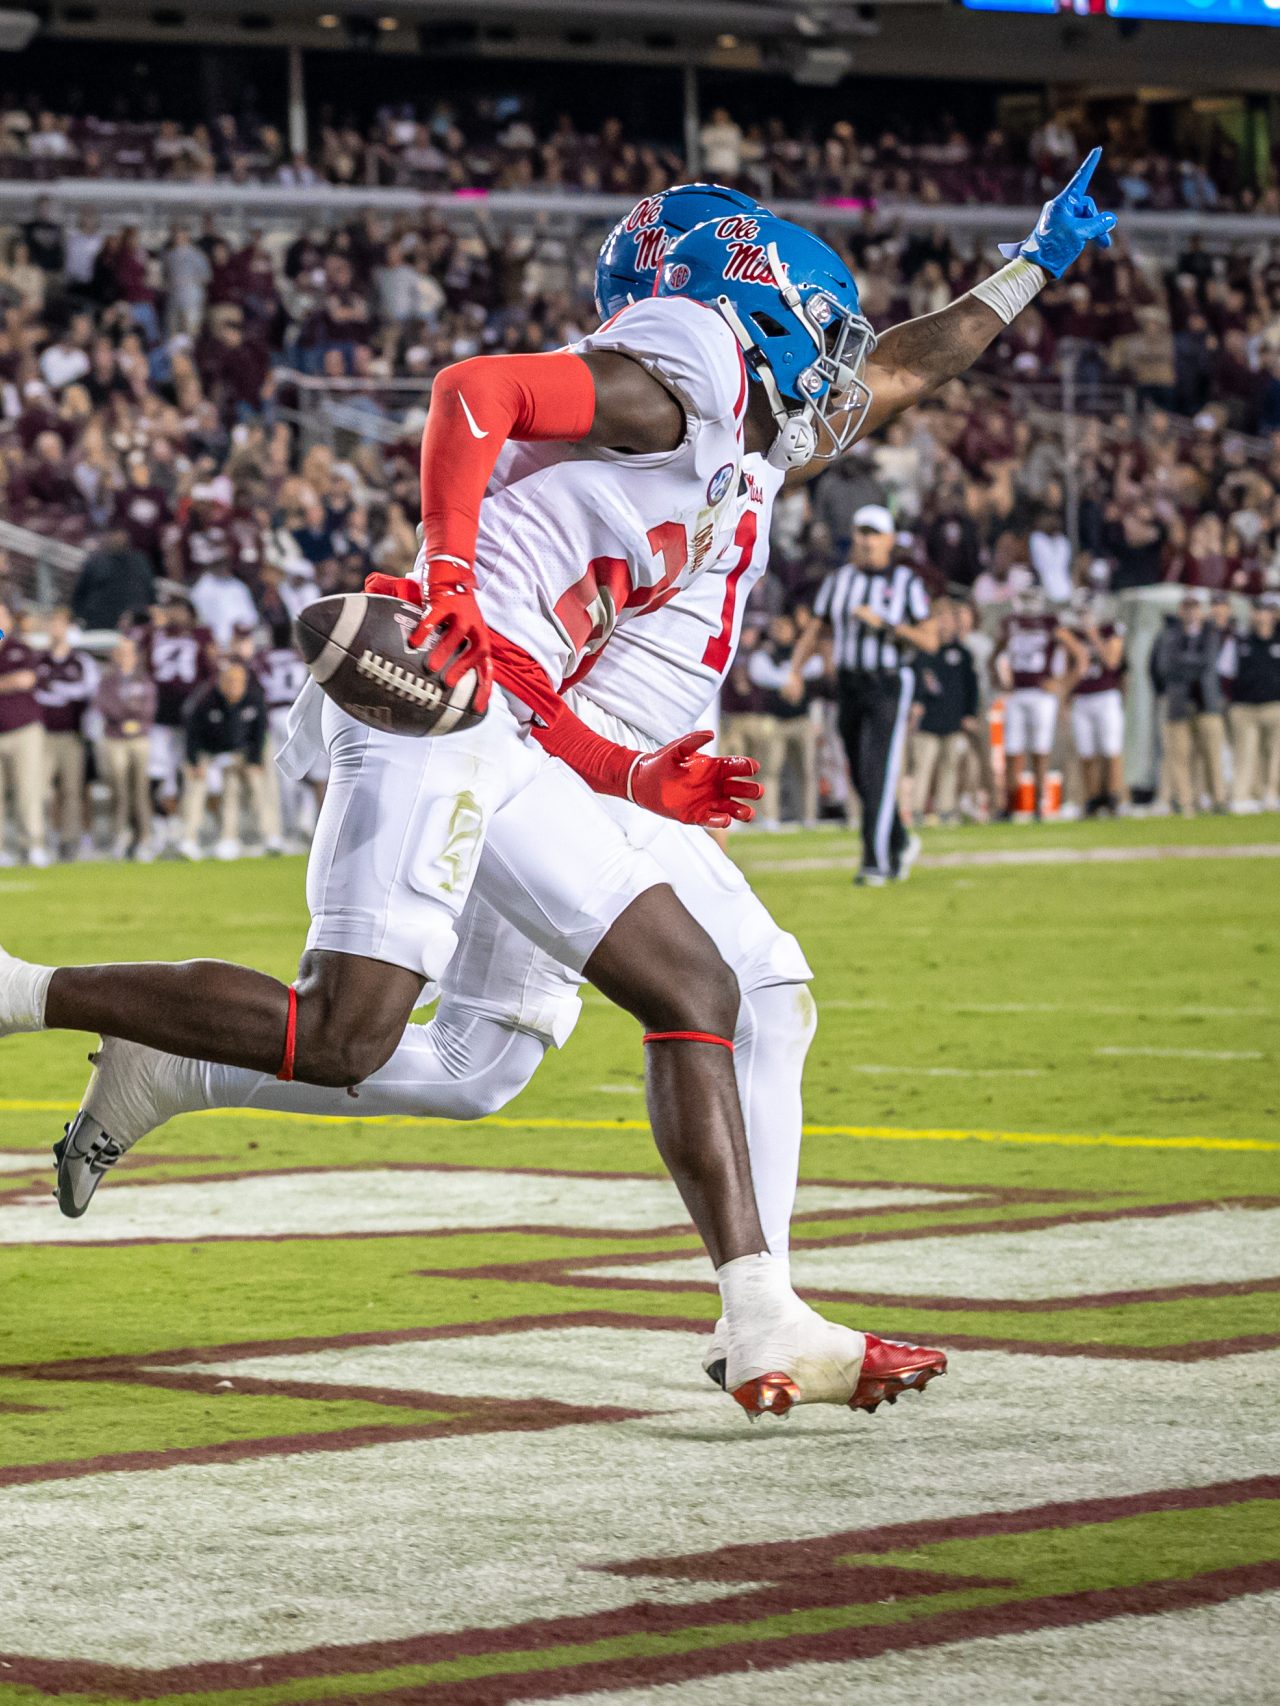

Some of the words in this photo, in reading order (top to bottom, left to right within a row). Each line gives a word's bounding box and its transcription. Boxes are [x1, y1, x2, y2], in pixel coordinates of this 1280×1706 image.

[626, 196, 665, 233] Ole
[715, 216, 760, 240] Ole
[634, 226, 678, 272] Mi
[723, 241, 790, 290] Mis
[670, 265, 691, 288] SEC
[701, 509, 757, 675] 1
